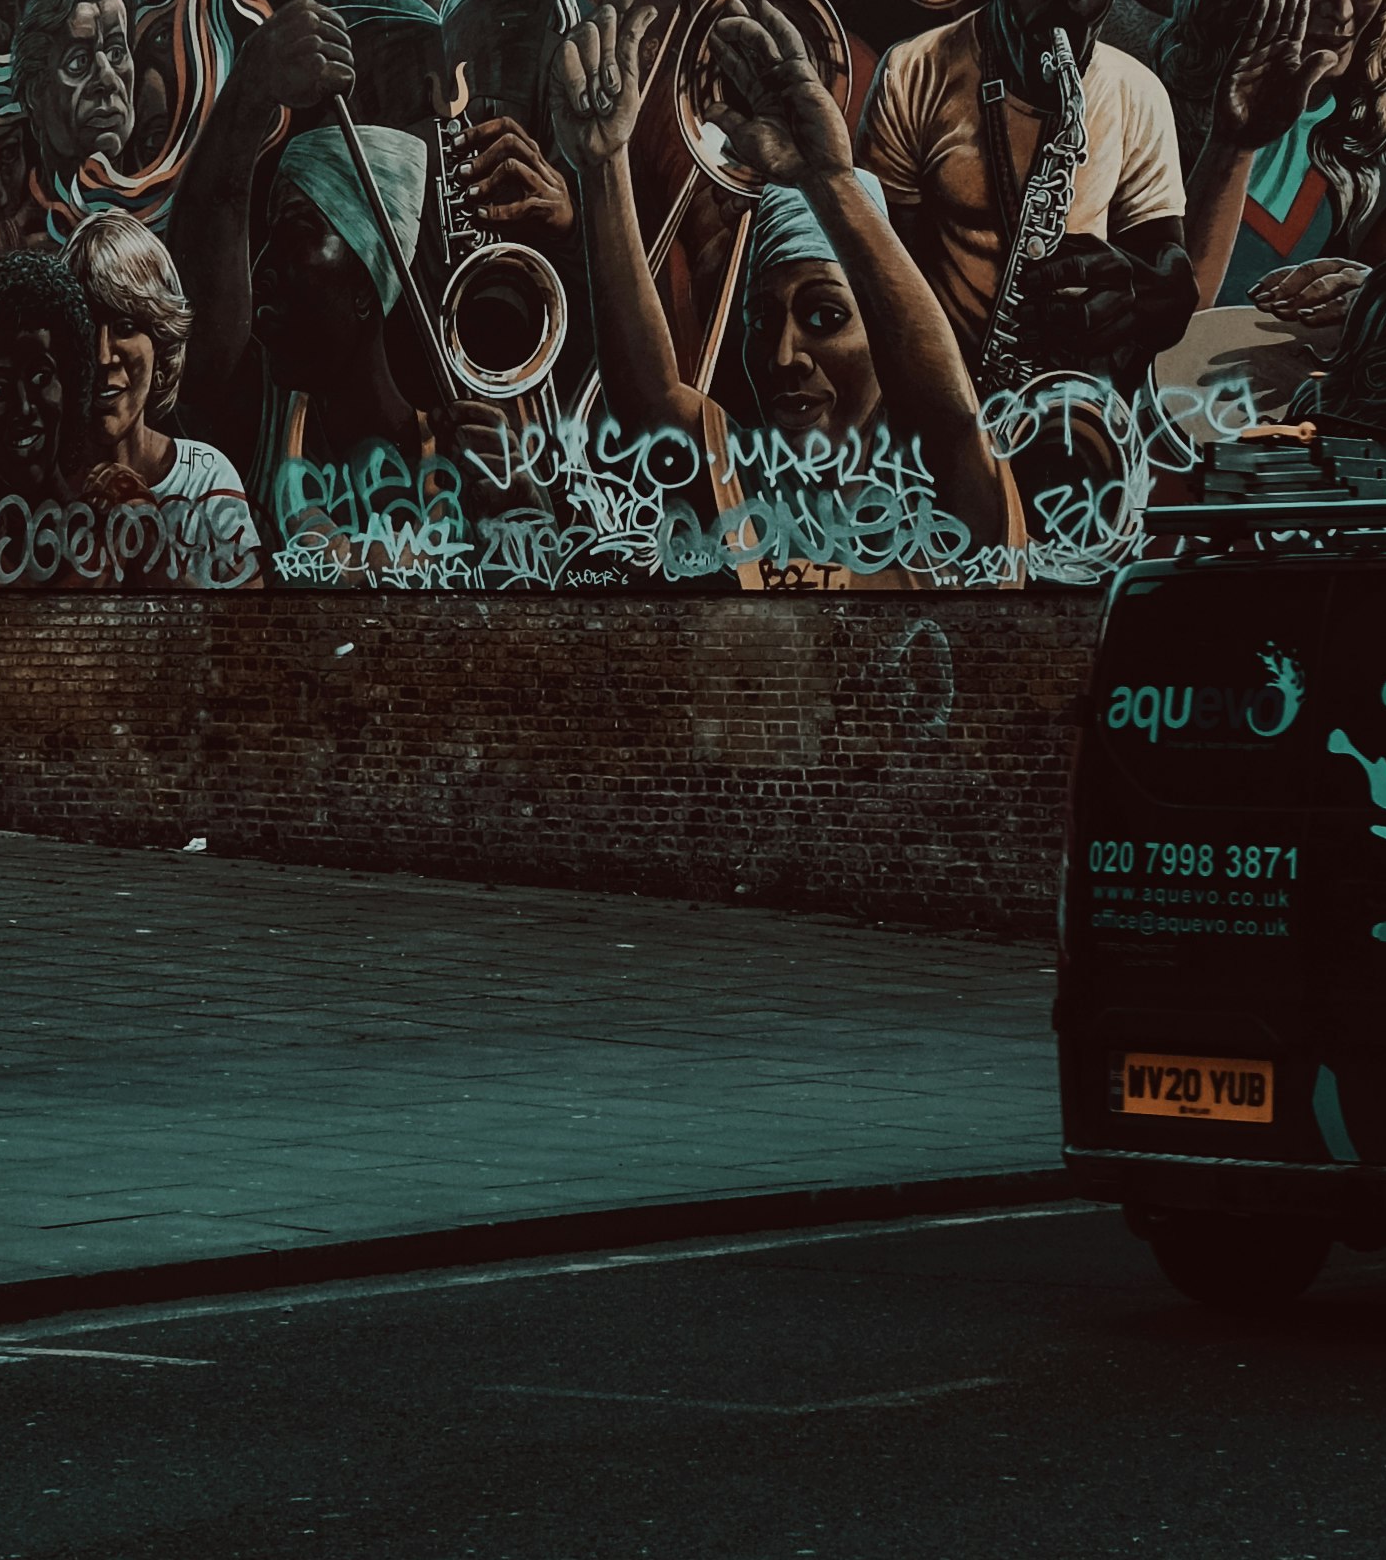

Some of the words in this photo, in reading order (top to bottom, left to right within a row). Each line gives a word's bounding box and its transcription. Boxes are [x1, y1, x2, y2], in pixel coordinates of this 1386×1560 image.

[1106, 683, 1305, 744] aquevo
[1088, 839, 1135, 874] 020
[1144, 841, 1215, 878] 7998
[1224, 843, 1299, 880] 3871
[1092, 885, 1291, 908] www.aquevo.co.uk
[1091, 908, 1290, 937] office@aquevo.co.uk
[1127, 1064, 1202, 1103] WV20
[1209, 1069, 1266, 1107] YUB
